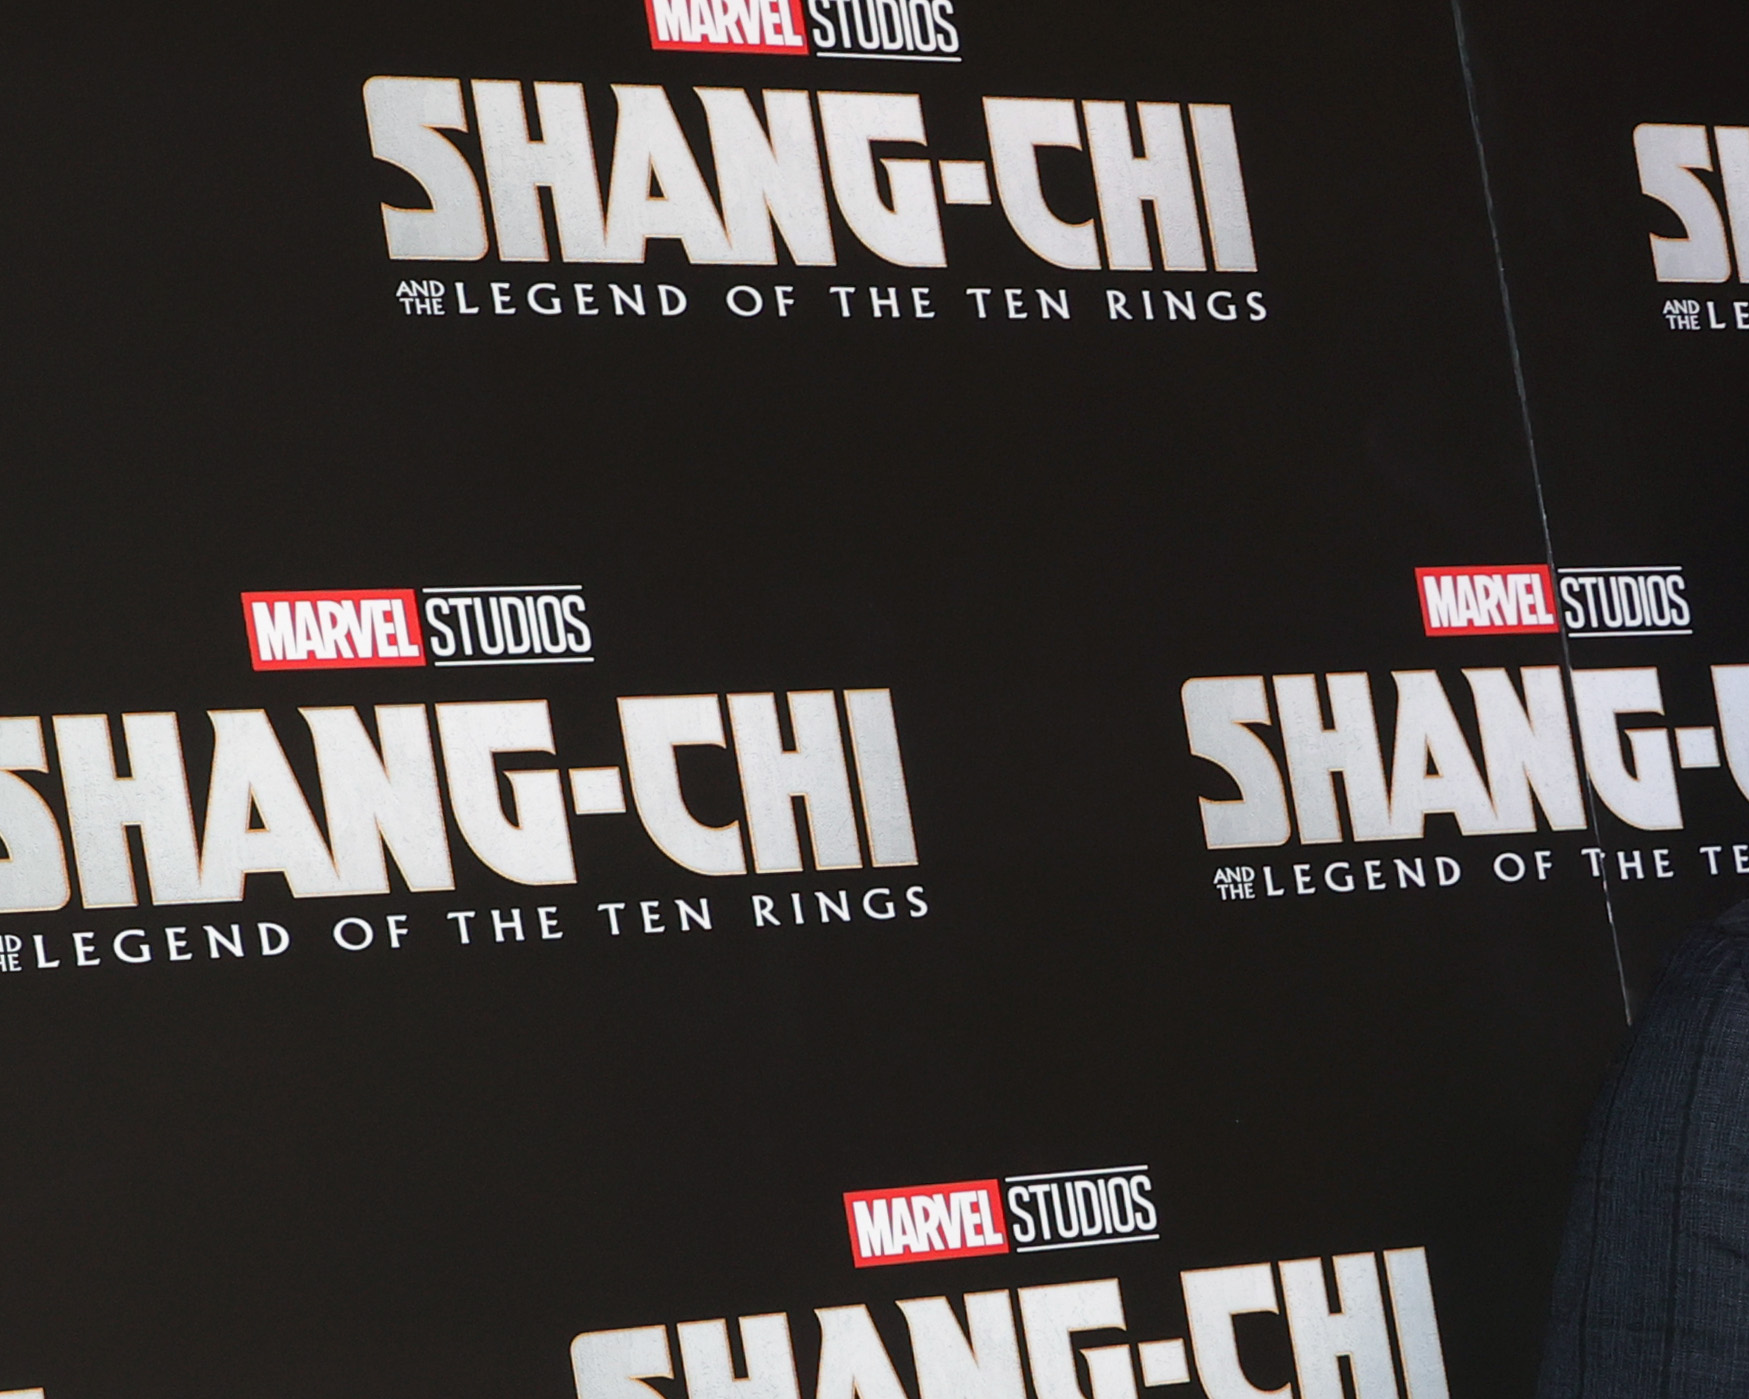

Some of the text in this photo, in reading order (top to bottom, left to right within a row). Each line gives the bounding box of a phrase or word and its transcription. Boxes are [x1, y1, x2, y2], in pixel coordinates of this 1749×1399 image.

[652, 0, 959, 52] MARVEL STUDIOS
[363, 76, 1257, 272] SHANG-CHI
[396, 280, 445, 297] AND
[399, 298, 445, 315] THE
[455, 282, 1266, 320] LEGEND OF THE TEN RINGS
[1663, 300, 1700, 314] AND
[1666, 315, 1700, 330] THE
[1423, 571, 1690, 628] MARVEL STUDIOS
[252, 595, 591, 661] MARVEL STUDIOS
[1214, 867, 1255, 884] AND
[1217, 883, 1255, 900] THE
[1263, 857, 1460, 896] LEGEND
[1494, 851, 1551, 881] OF
[1581, 848, 1673, 879] THE
[33, 923, 289, 968] LEGEND
[333, 915, 408, 950] OF
[447, 907, 563, 944] THE
[598, 898, 712, 935] TEN
[752, 886, 928, 926] RINGS
[853, 1175, 1157, 1257] MARVEL STUDIOS
